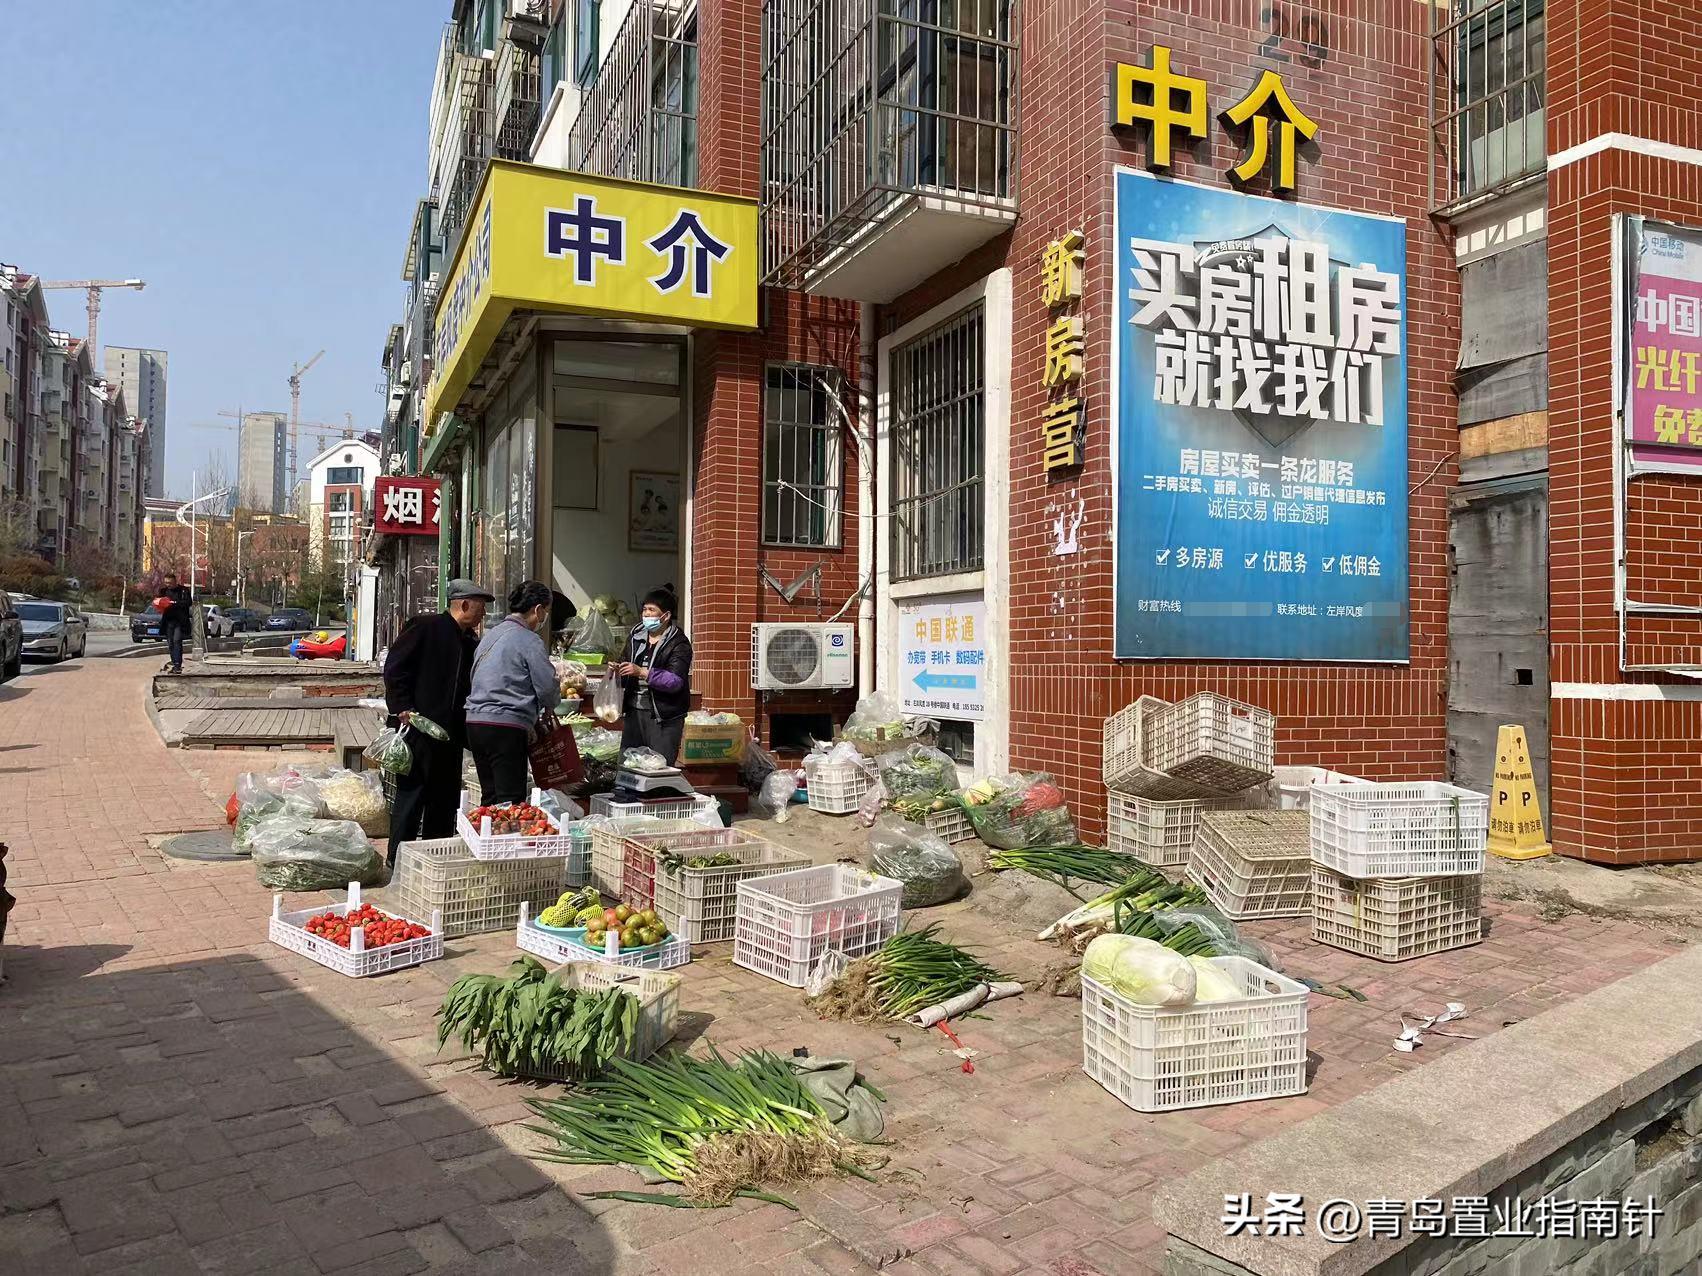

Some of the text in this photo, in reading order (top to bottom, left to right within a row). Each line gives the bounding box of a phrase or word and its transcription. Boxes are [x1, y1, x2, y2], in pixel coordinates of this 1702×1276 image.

[1111, 44, 1319, 192] 中介
[543, 192, 735, 299] 中介
[1651, 236, 1685, 252] 中国移动
[1128, 236, 1402, 355] 买房租房
[1636, 288, 1702, 338] 中国
[1153, 329, 1384, 426] 就找我们
[1636, 345, 1702, 394] 光纤
[1180, 448, 1354, 487] 房屋买卖一条龙服务
[1142, 475, 1386, 506] 二手房买卖、新房、评估、过户销售代理信息发布
[1208, 497, 1329, 525] 诚信交易 佣金透明
[1176, 546, 1382, 577] 多房源 优服务 低佣金
[1137, 599, 1182, 613] 财富热线
[915, 615, 975, 643] 中国联通
[907, 650, 985, 665] 办宽带 手机卡 数码配件
[1500, 790, 1508, 805] P
[1522, 791, 1531, 806] P
